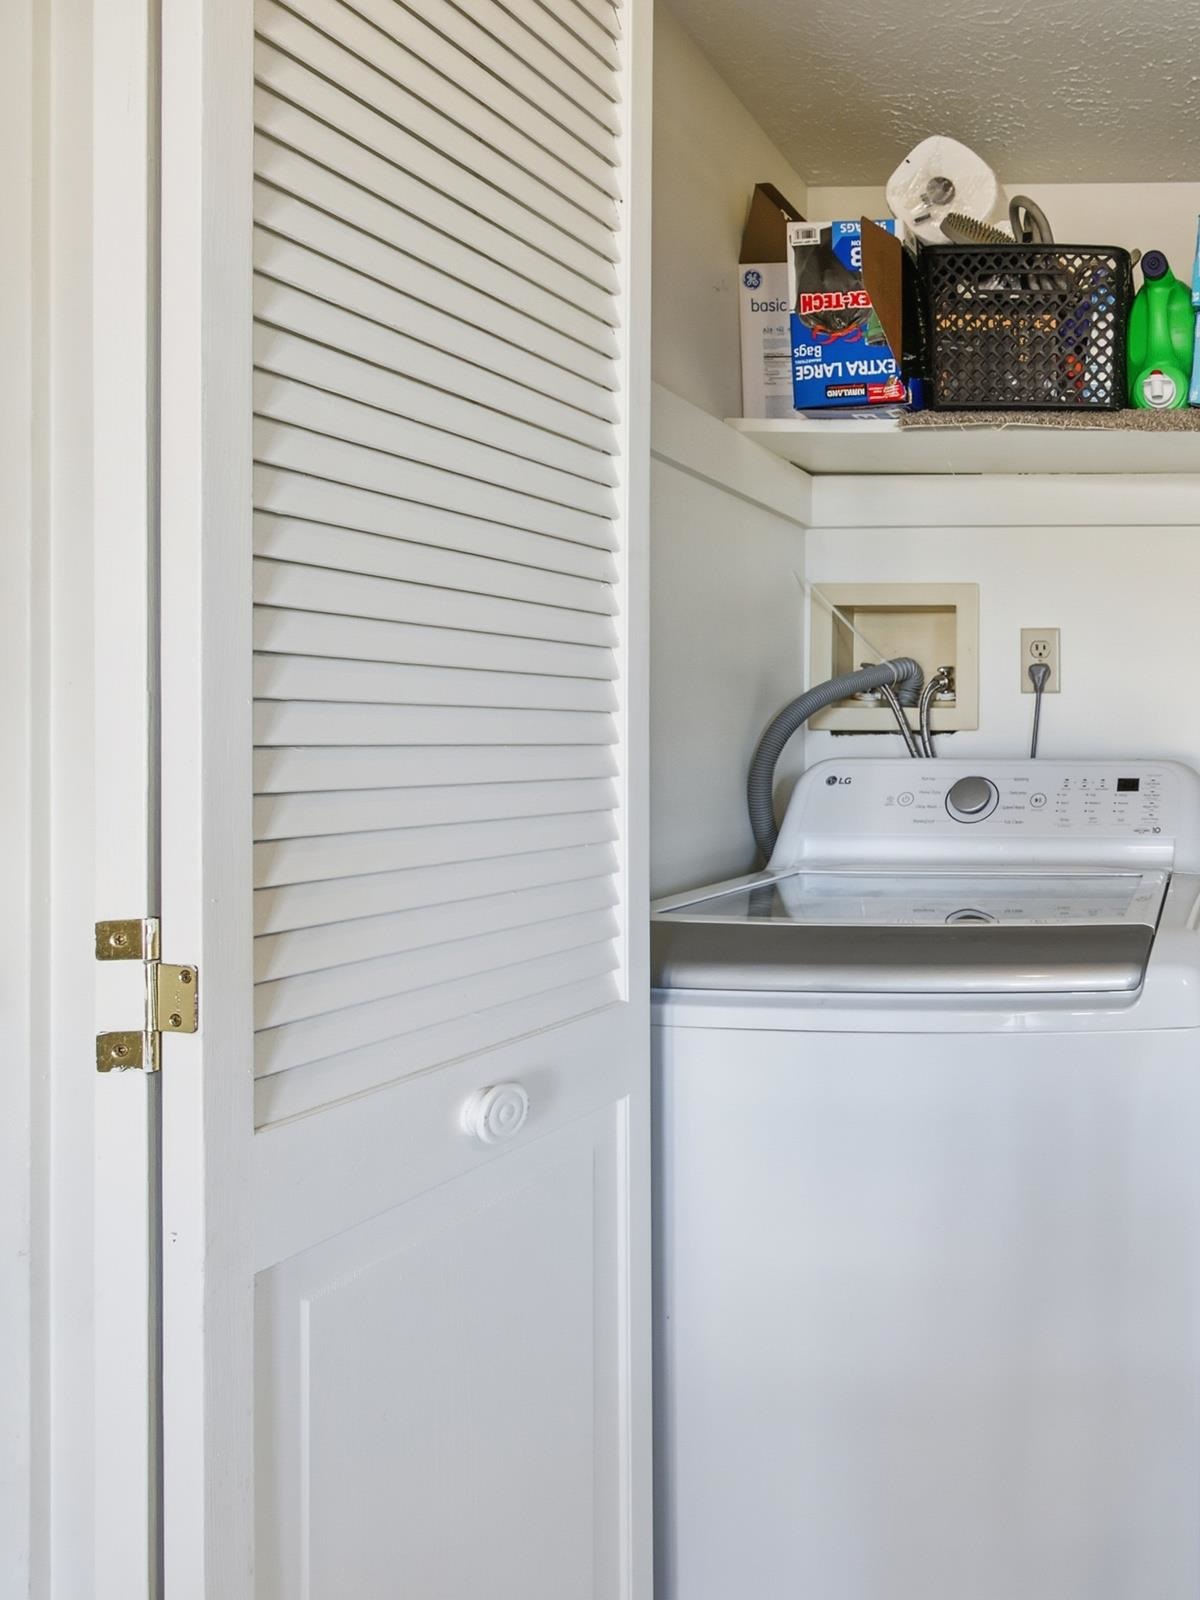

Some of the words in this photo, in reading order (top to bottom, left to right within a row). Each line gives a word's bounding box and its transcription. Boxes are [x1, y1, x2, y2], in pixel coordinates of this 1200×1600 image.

[840, 223, 861, 233] AGS
[751, 297, 787, 312] basic
[801, 290, 872, 313] EX-TECH
[794, 345, 822, 358] Bags
[796, 362, 843, 380] LARGE
[847, 358, 896, 377] EXTRA
[838, 777, 852, 785] LG
